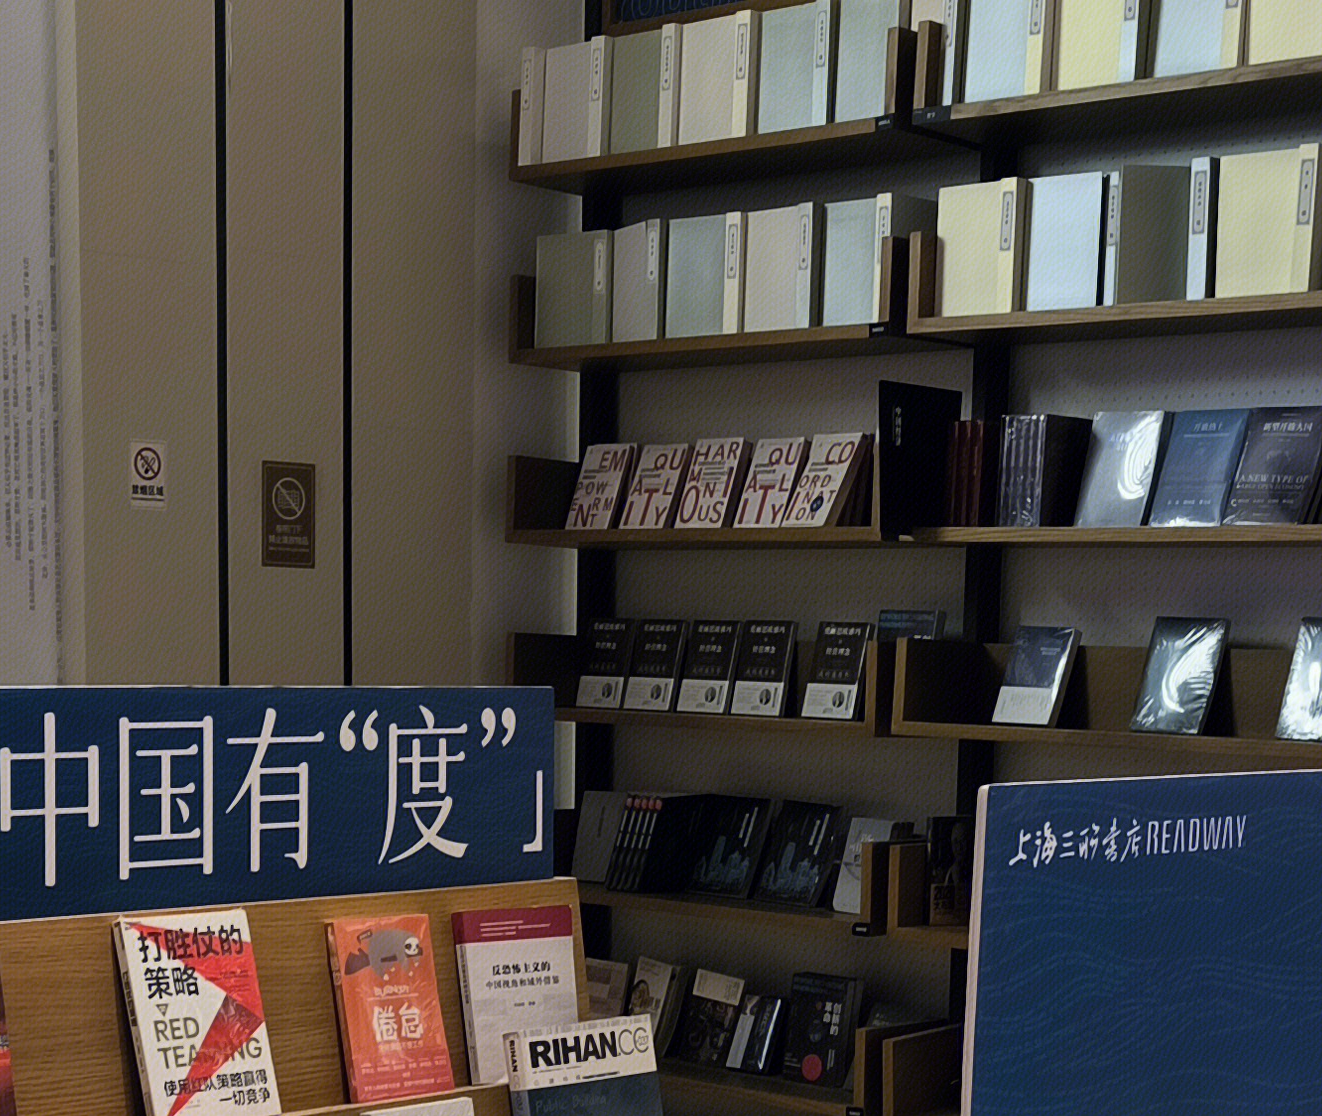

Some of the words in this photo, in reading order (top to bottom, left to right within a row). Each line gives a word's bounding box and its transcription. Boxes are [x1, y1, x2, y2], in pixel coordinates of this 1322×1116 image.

[1144, 813, 1248, 855] READWAY
[137, 923, 245, 964] 打胜仗的
[143, 964, 200, 1000] 策略
[153, 1016, 200, 1042] RED
[219, 1087, 271, 1107] 一切竞争
